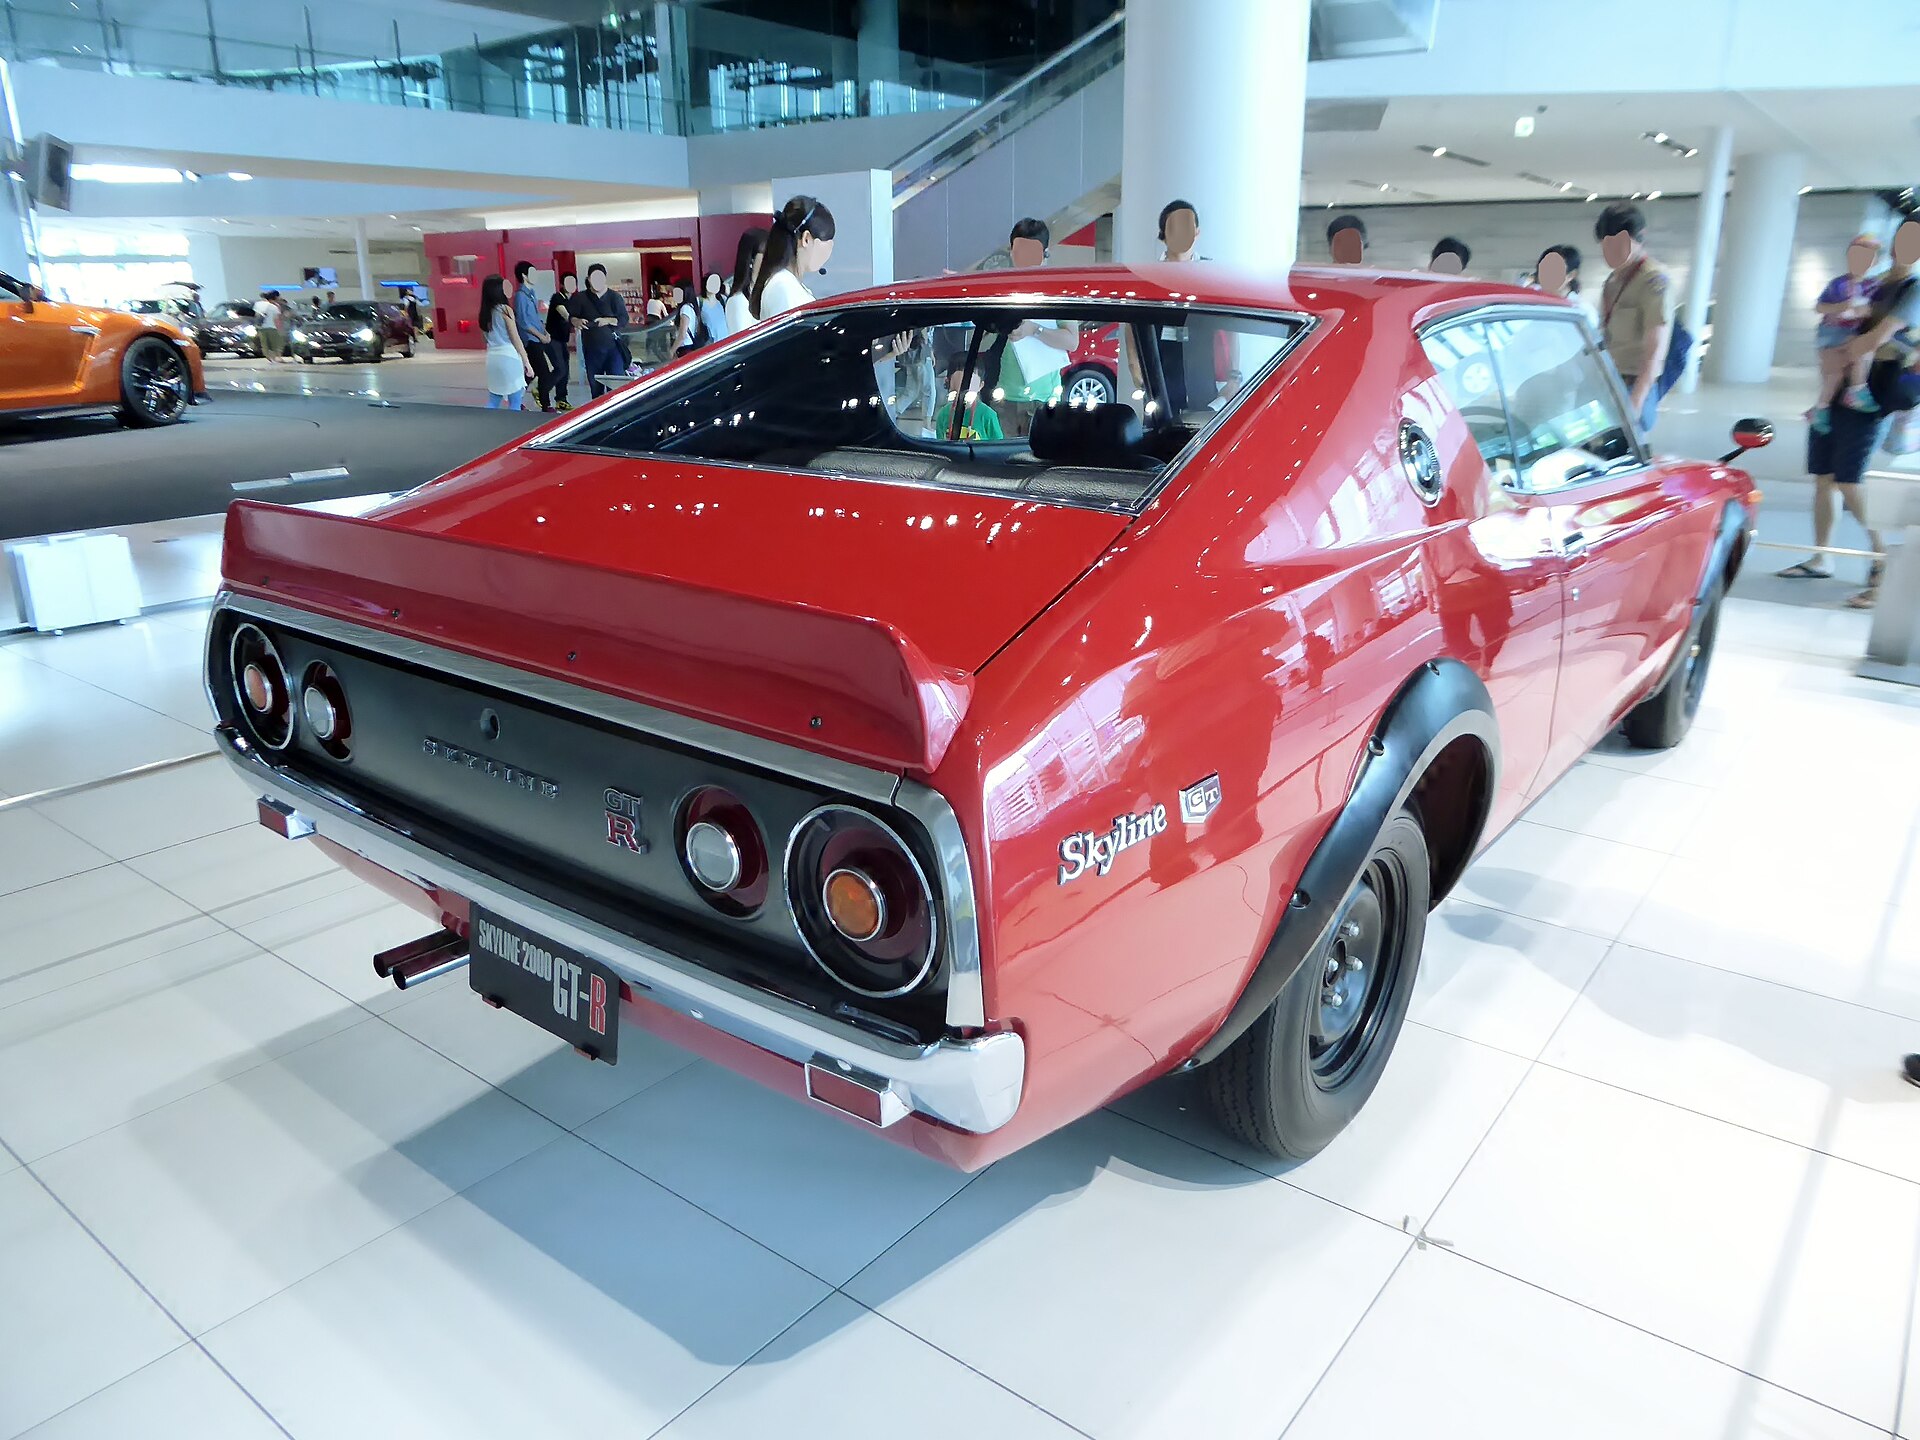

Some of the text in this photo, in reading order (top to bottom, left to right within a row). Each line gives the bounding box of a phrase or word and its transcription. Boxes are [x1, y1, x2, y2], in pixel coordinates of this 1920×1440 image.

[423, 738, 558, 798] SKYLINE
[603, 787, 642, 816] GT
[605, 810, 644, 854] R
[1057, 787, 1219, 886] Skyline GT
[479, 920, 607, 1035] SKYLINE 2000 GT-R
